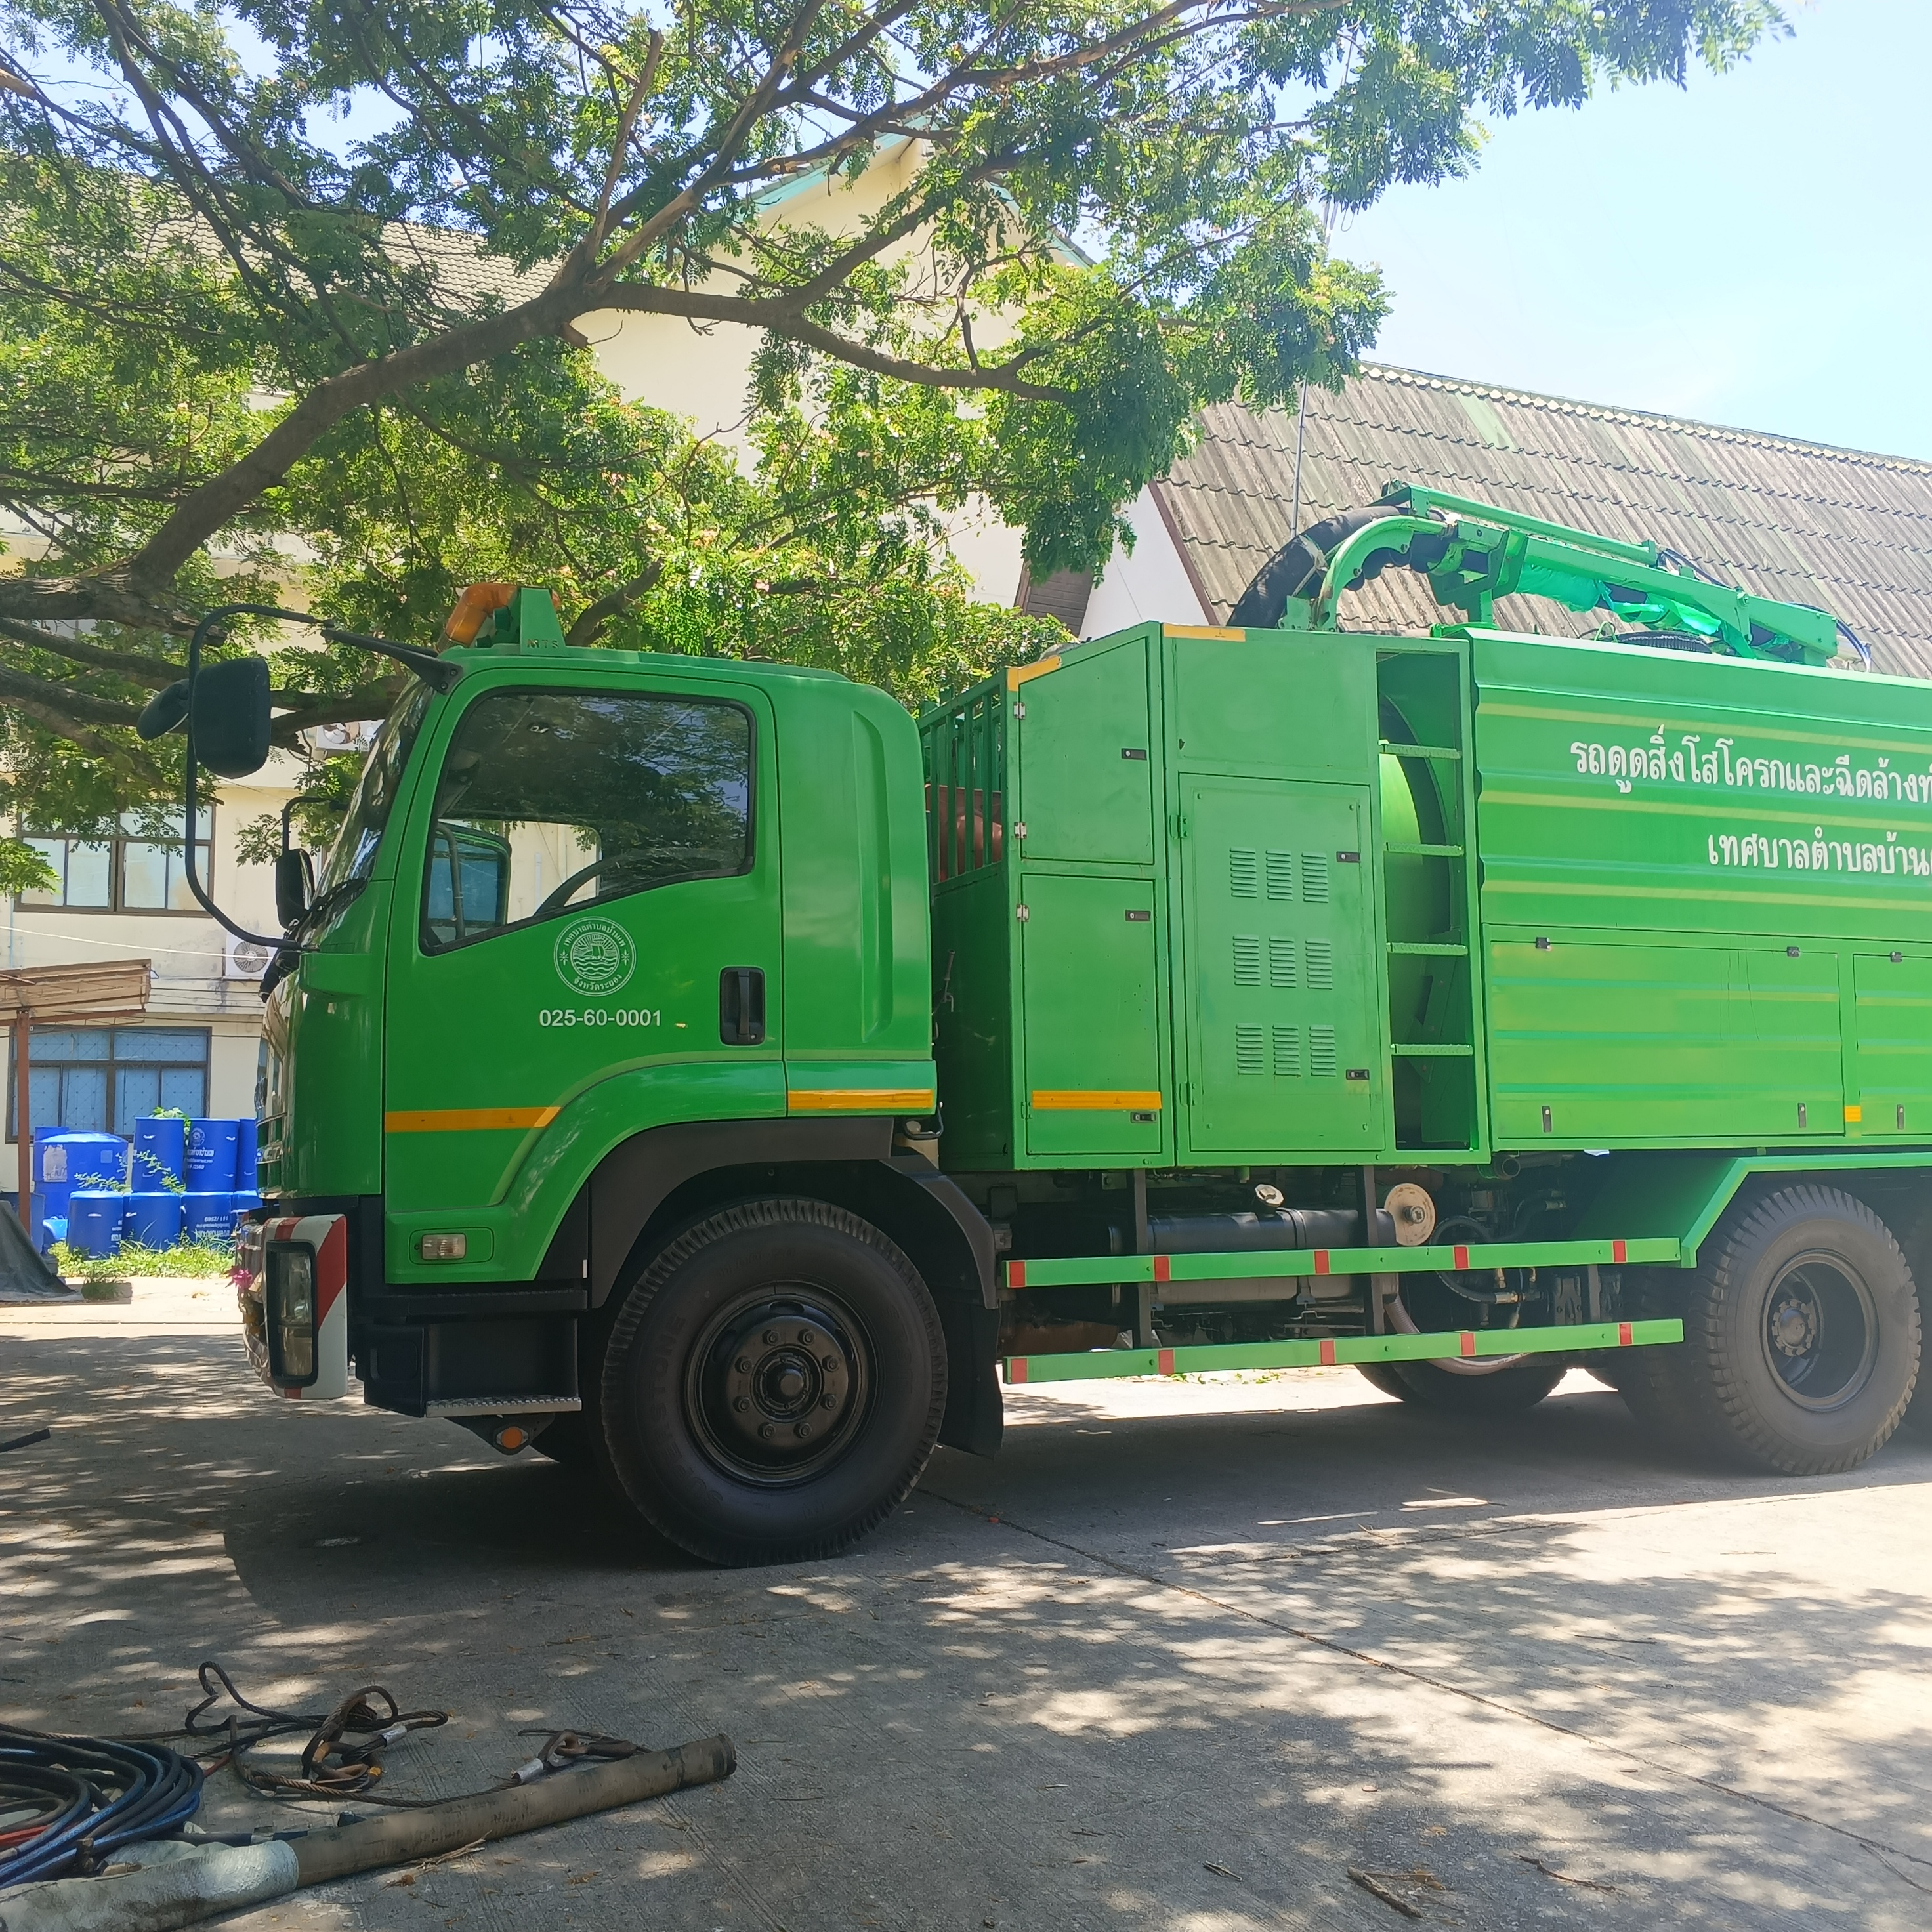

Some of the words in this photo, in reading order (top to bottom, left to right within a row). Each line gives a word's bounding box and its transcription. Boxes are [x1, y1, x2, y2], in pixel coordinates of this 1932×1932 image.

[1708, 826, 1932, 876] เทศบาลตำบลบ้าน
[539, 1009, 661, 1026] 025-60-0001
[648, 1314, 724, 1507] SUPERSTONE
